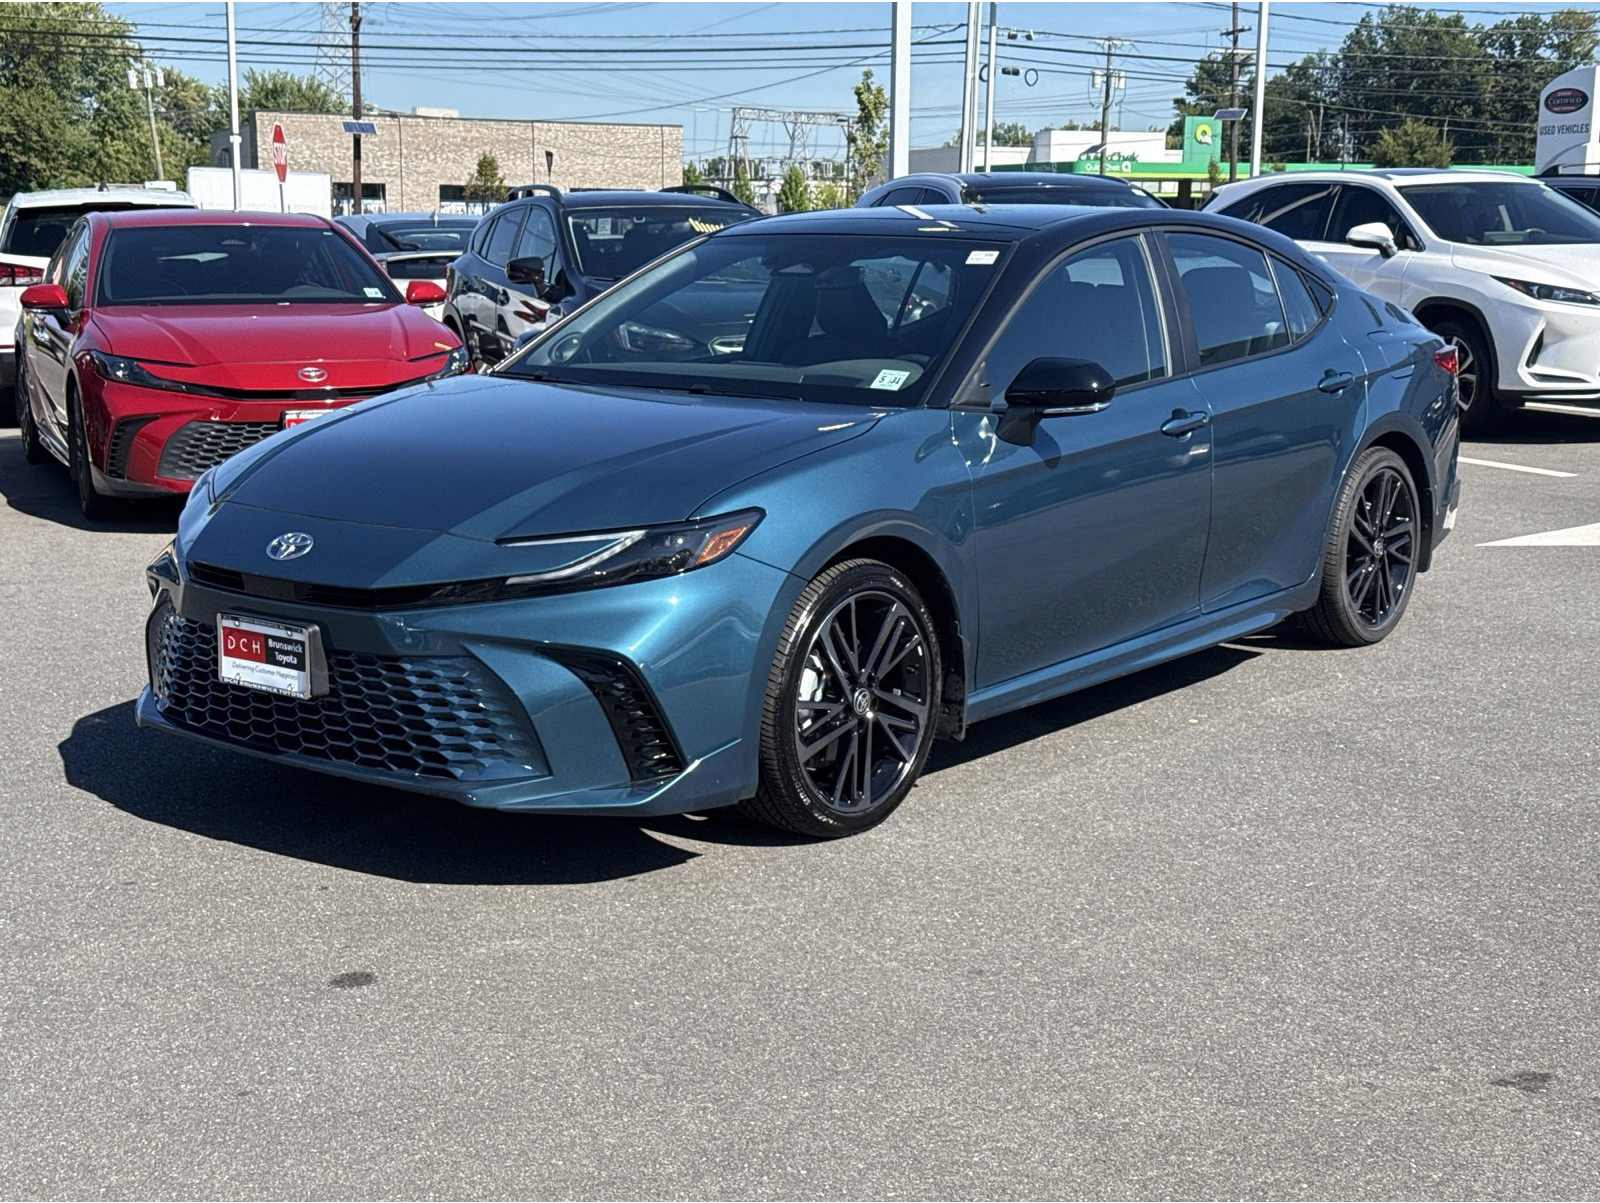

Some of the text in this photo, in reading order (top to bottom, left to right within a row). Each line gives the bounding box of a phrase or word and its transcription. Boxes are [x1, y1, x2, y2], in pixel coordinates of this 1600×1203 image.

[1540, 123, 1590, 136] USED VEHICLES
[272, 142, 287, 165] STOP
[268, 638, 303, 653] Brunswick
[275, 652, 298, 665] Toyota
